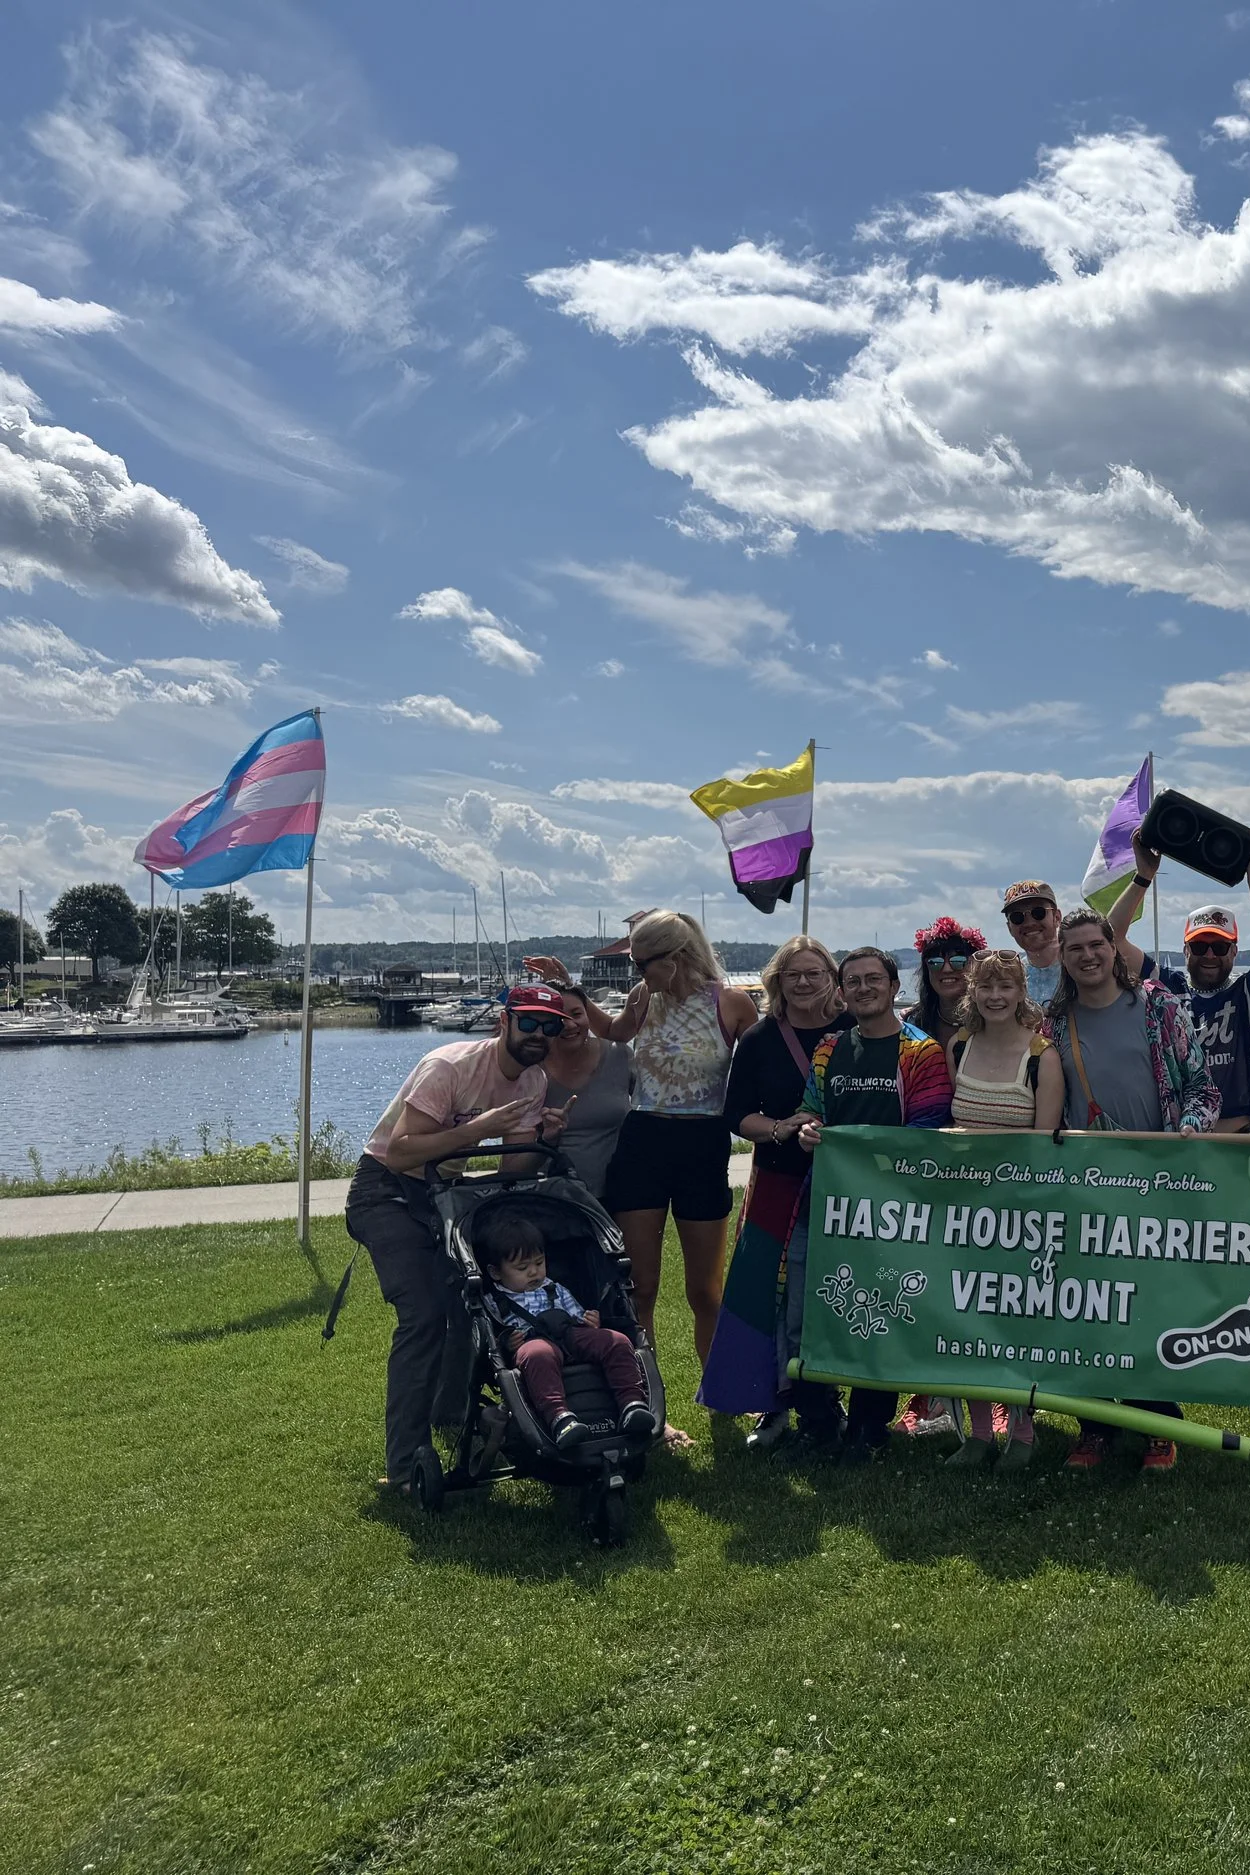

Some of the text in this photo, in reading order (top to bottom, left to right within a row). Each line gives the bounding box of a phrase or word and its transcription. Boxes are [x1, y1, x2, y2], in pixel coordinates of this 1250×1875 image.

[894, 1158, 1216, 1195] the Drinking Club with a Running Problem
[823, 1195, 932, 1243] HASH
[943, 1204, 1066, 1252] HOUSE
[1030, 1244, 1057, 1285] of
[951, 1269, 1137, 1324] VERMONT
[936, 1335, 1136, 1369] hashvermont.com
